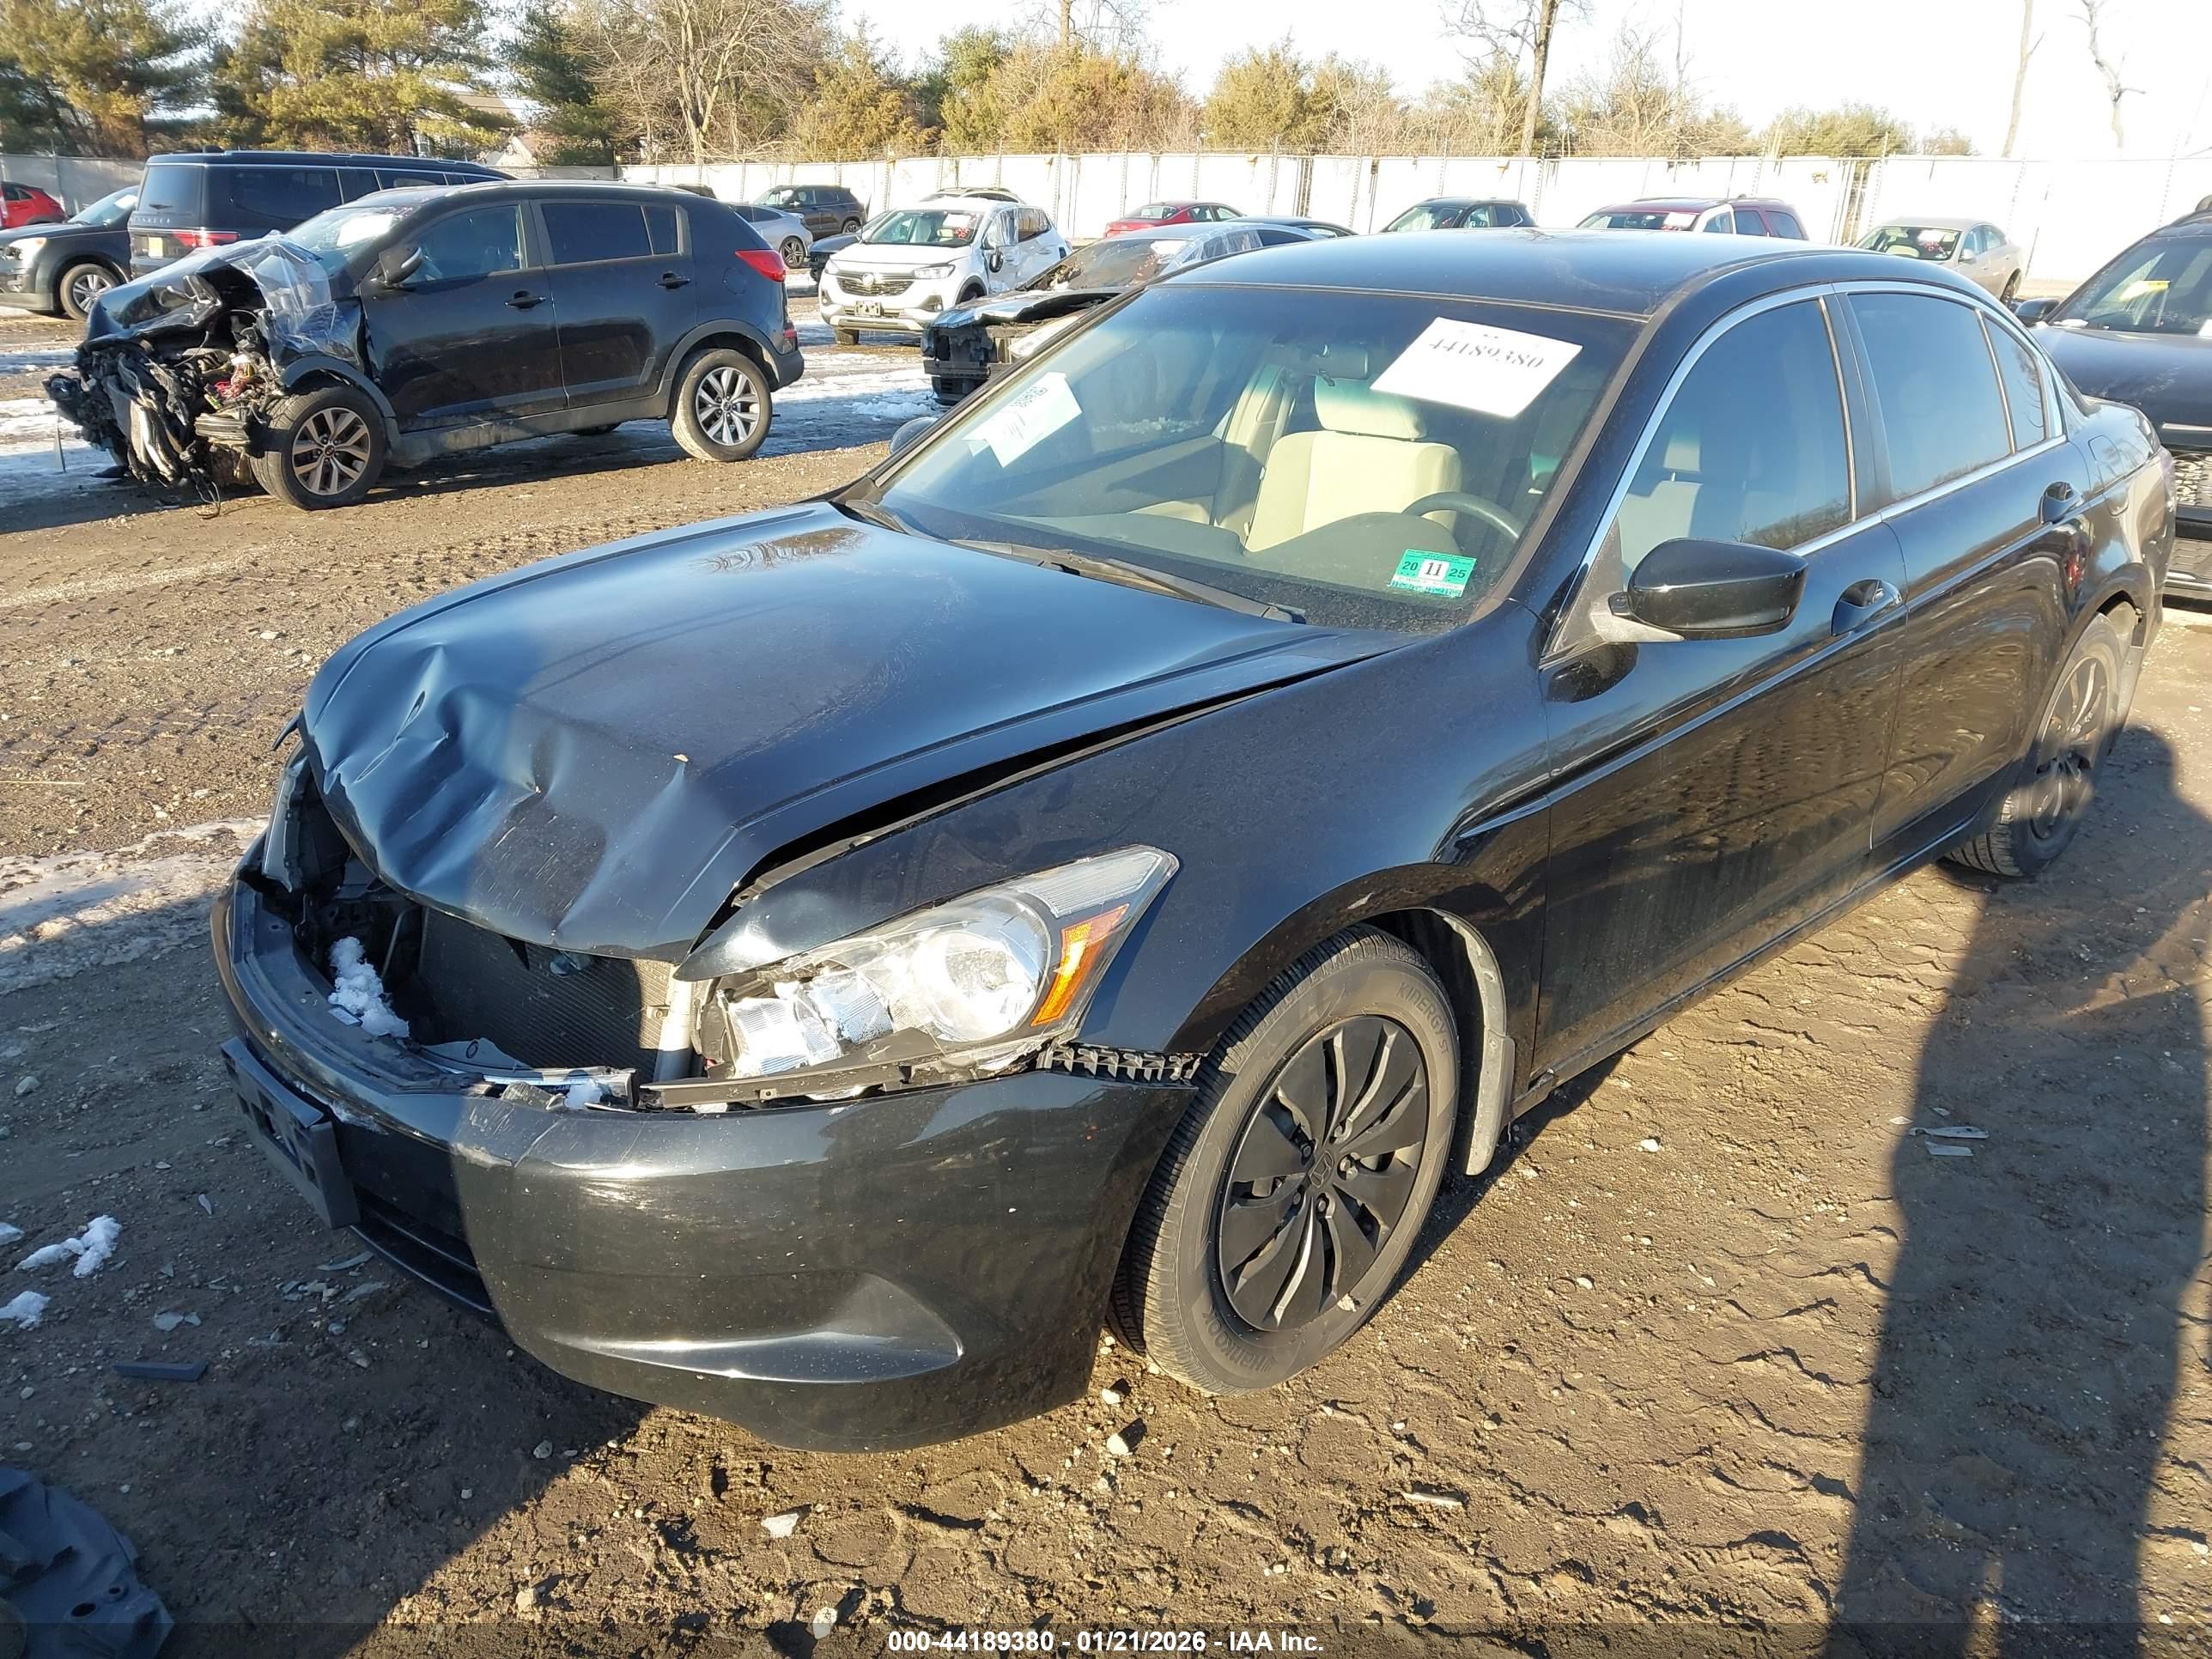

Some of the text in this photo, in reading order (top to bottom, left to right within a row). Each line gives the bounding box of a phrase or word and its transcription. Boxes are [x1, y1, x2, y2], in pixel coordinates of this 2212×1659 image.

[1429, 338, 1544, 368] 44189380
[1401, 561, 1468, 579] 20 11 25
[1395, 981, 1445, 1036] KINERGY
